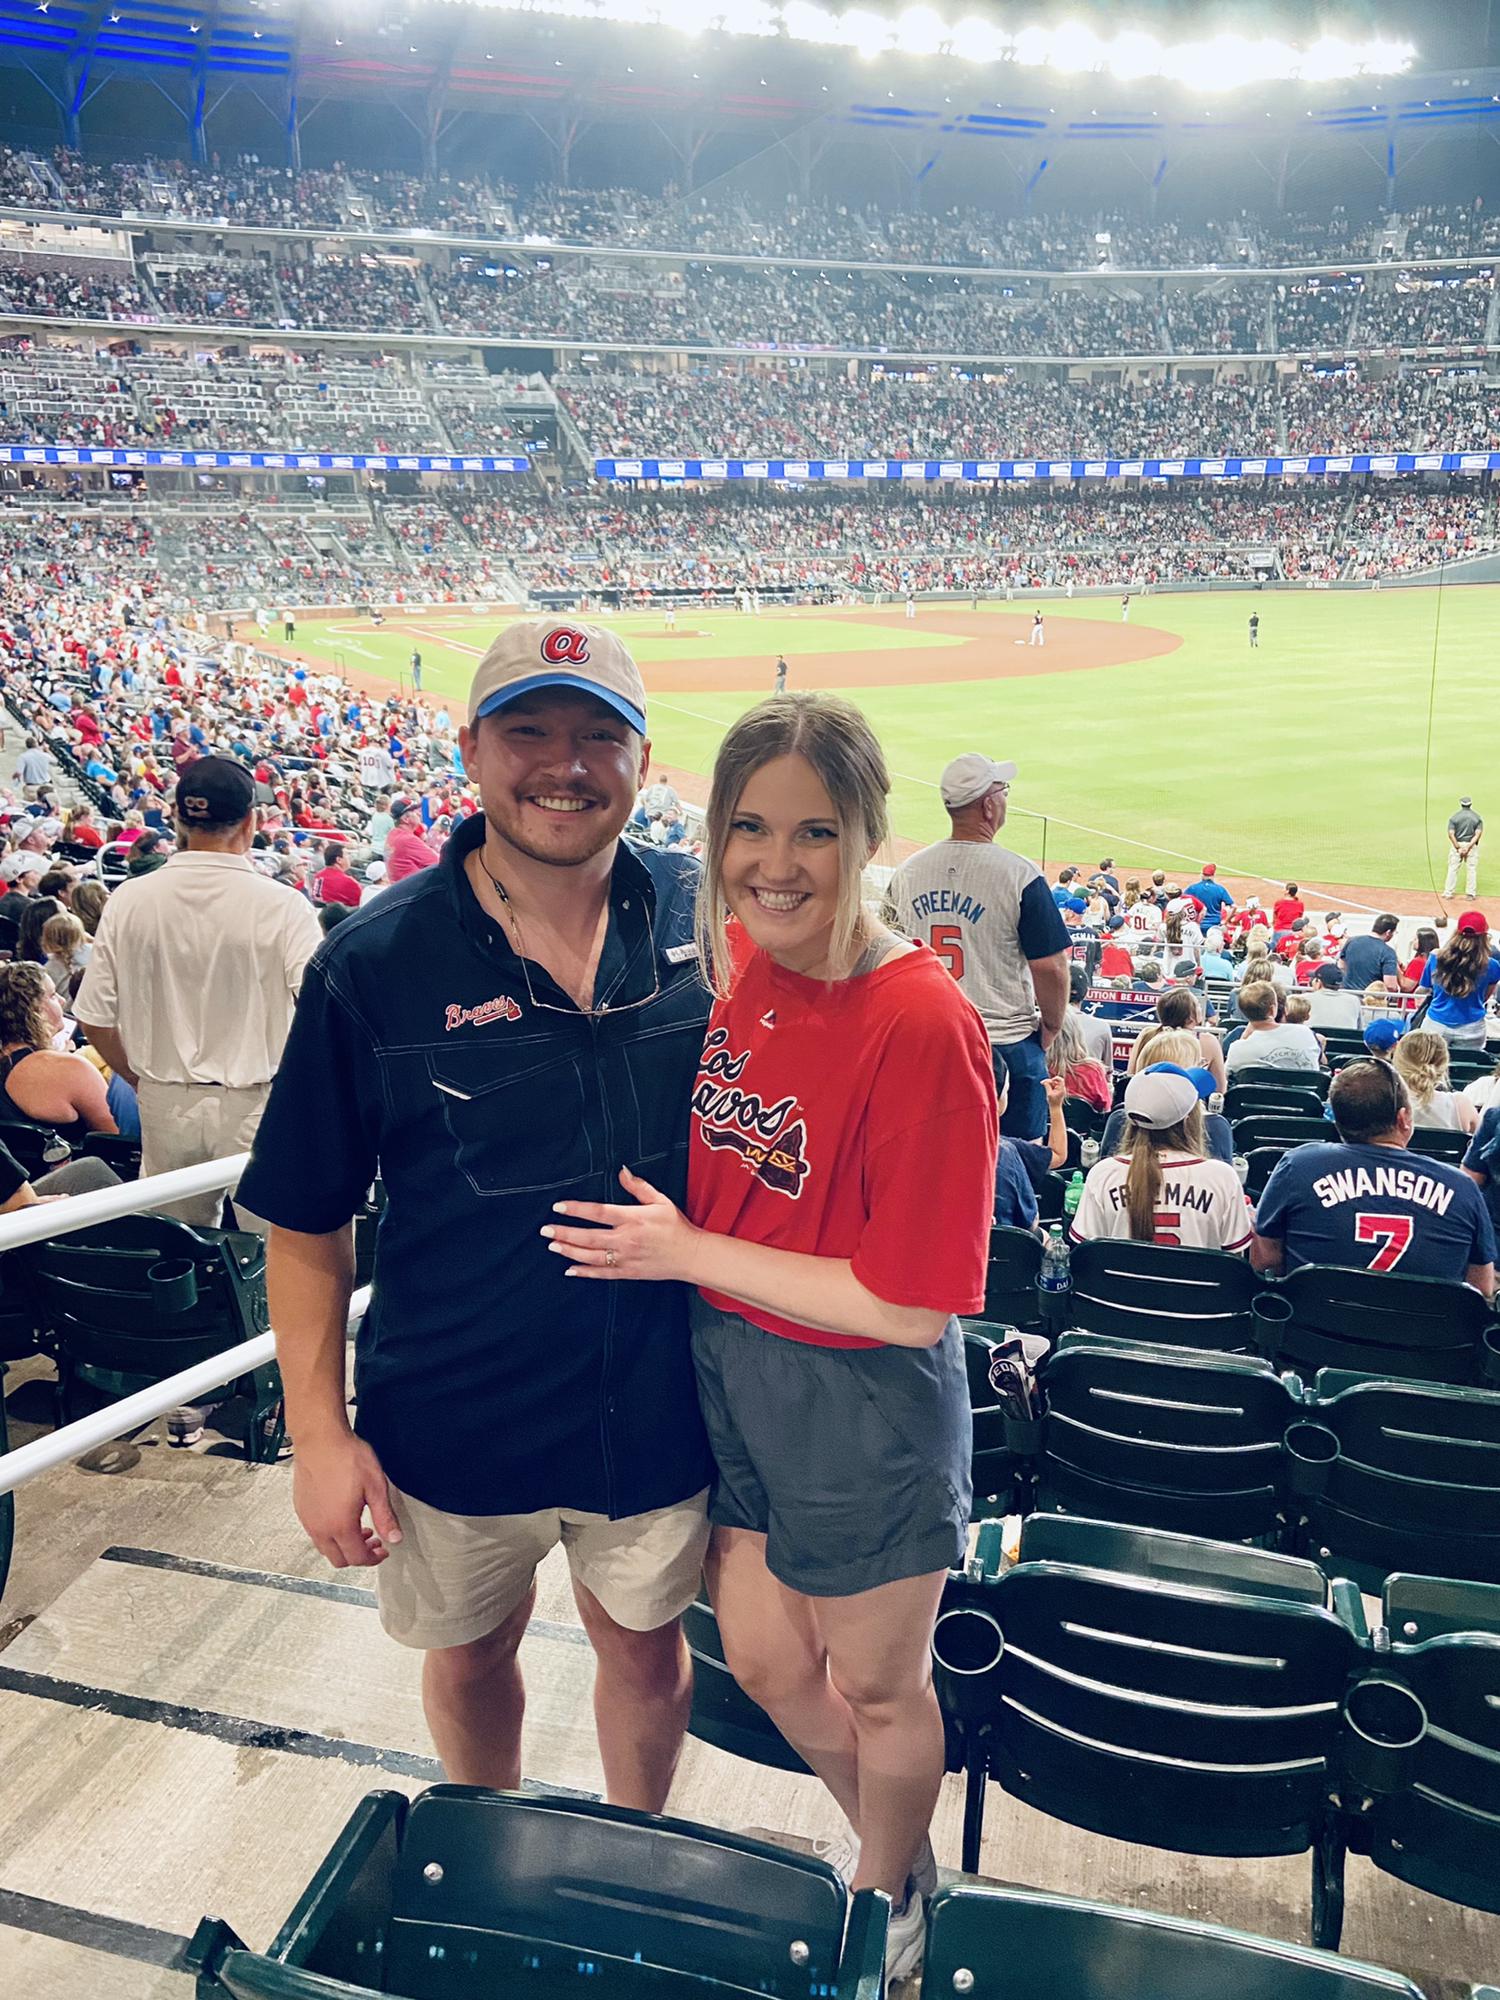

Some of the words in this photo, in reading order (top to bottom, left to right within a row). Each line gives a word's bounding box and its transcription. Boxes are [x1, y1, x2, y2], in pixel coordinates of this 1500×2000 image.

[911, 890, 986, 924] FREEMAN
[931, 924, 965, 981] 5
[446, 995, 505, 1031] Braves
[1120, 990, 1133, 1001] BE
[700, 1027, 751, 1082] Los
[1108, 1182, 1214, 1215] FRMAN
[1312, 1166, 1455, 1217] SWANSON
[1355, 1212, 1414, 1273] 7
